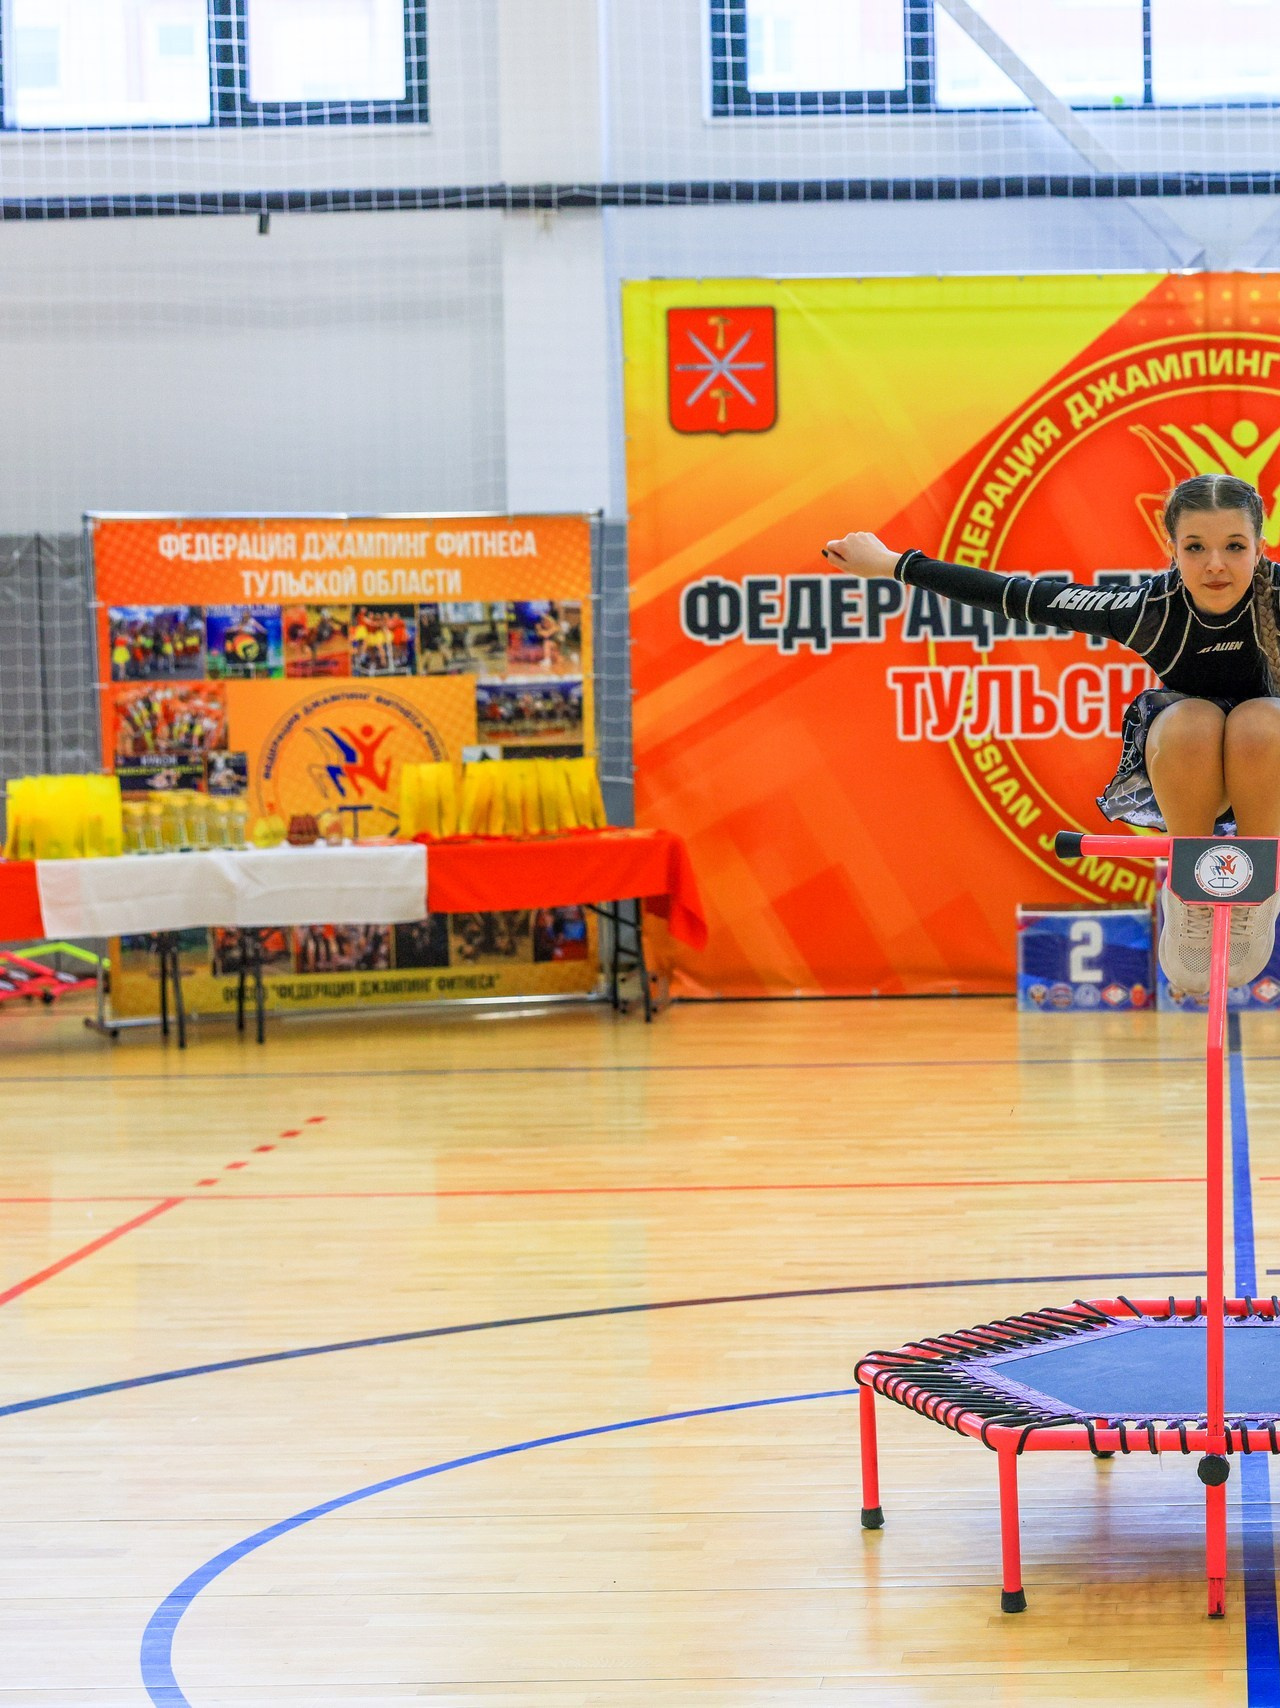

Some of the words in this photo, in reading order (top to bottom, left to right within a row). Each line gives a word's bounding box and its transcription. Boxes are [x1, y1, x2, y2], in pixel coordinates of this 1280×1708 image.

[954, 416, 1062, 569] ДЕРАЦИЯ
[158, 532, 297, 562] ФЕДЕРАЦИЯ
[302, 532, 432, 562] ДЖАМПИНГ
[435, 530, 537, 558] ФИТНЕСА
[240, 566, 357, 598] ТУЛЬСКОЙ
[362, 568, 462, 596] ОБЛАСТИ
[1047, 587, 1113, 611] ALIEN
[1210, 641, 1244, 653] ALIEN
[888, 663, 1160, 741] ТУЛЬСК
[1068, 919, 1104, 983] 2
